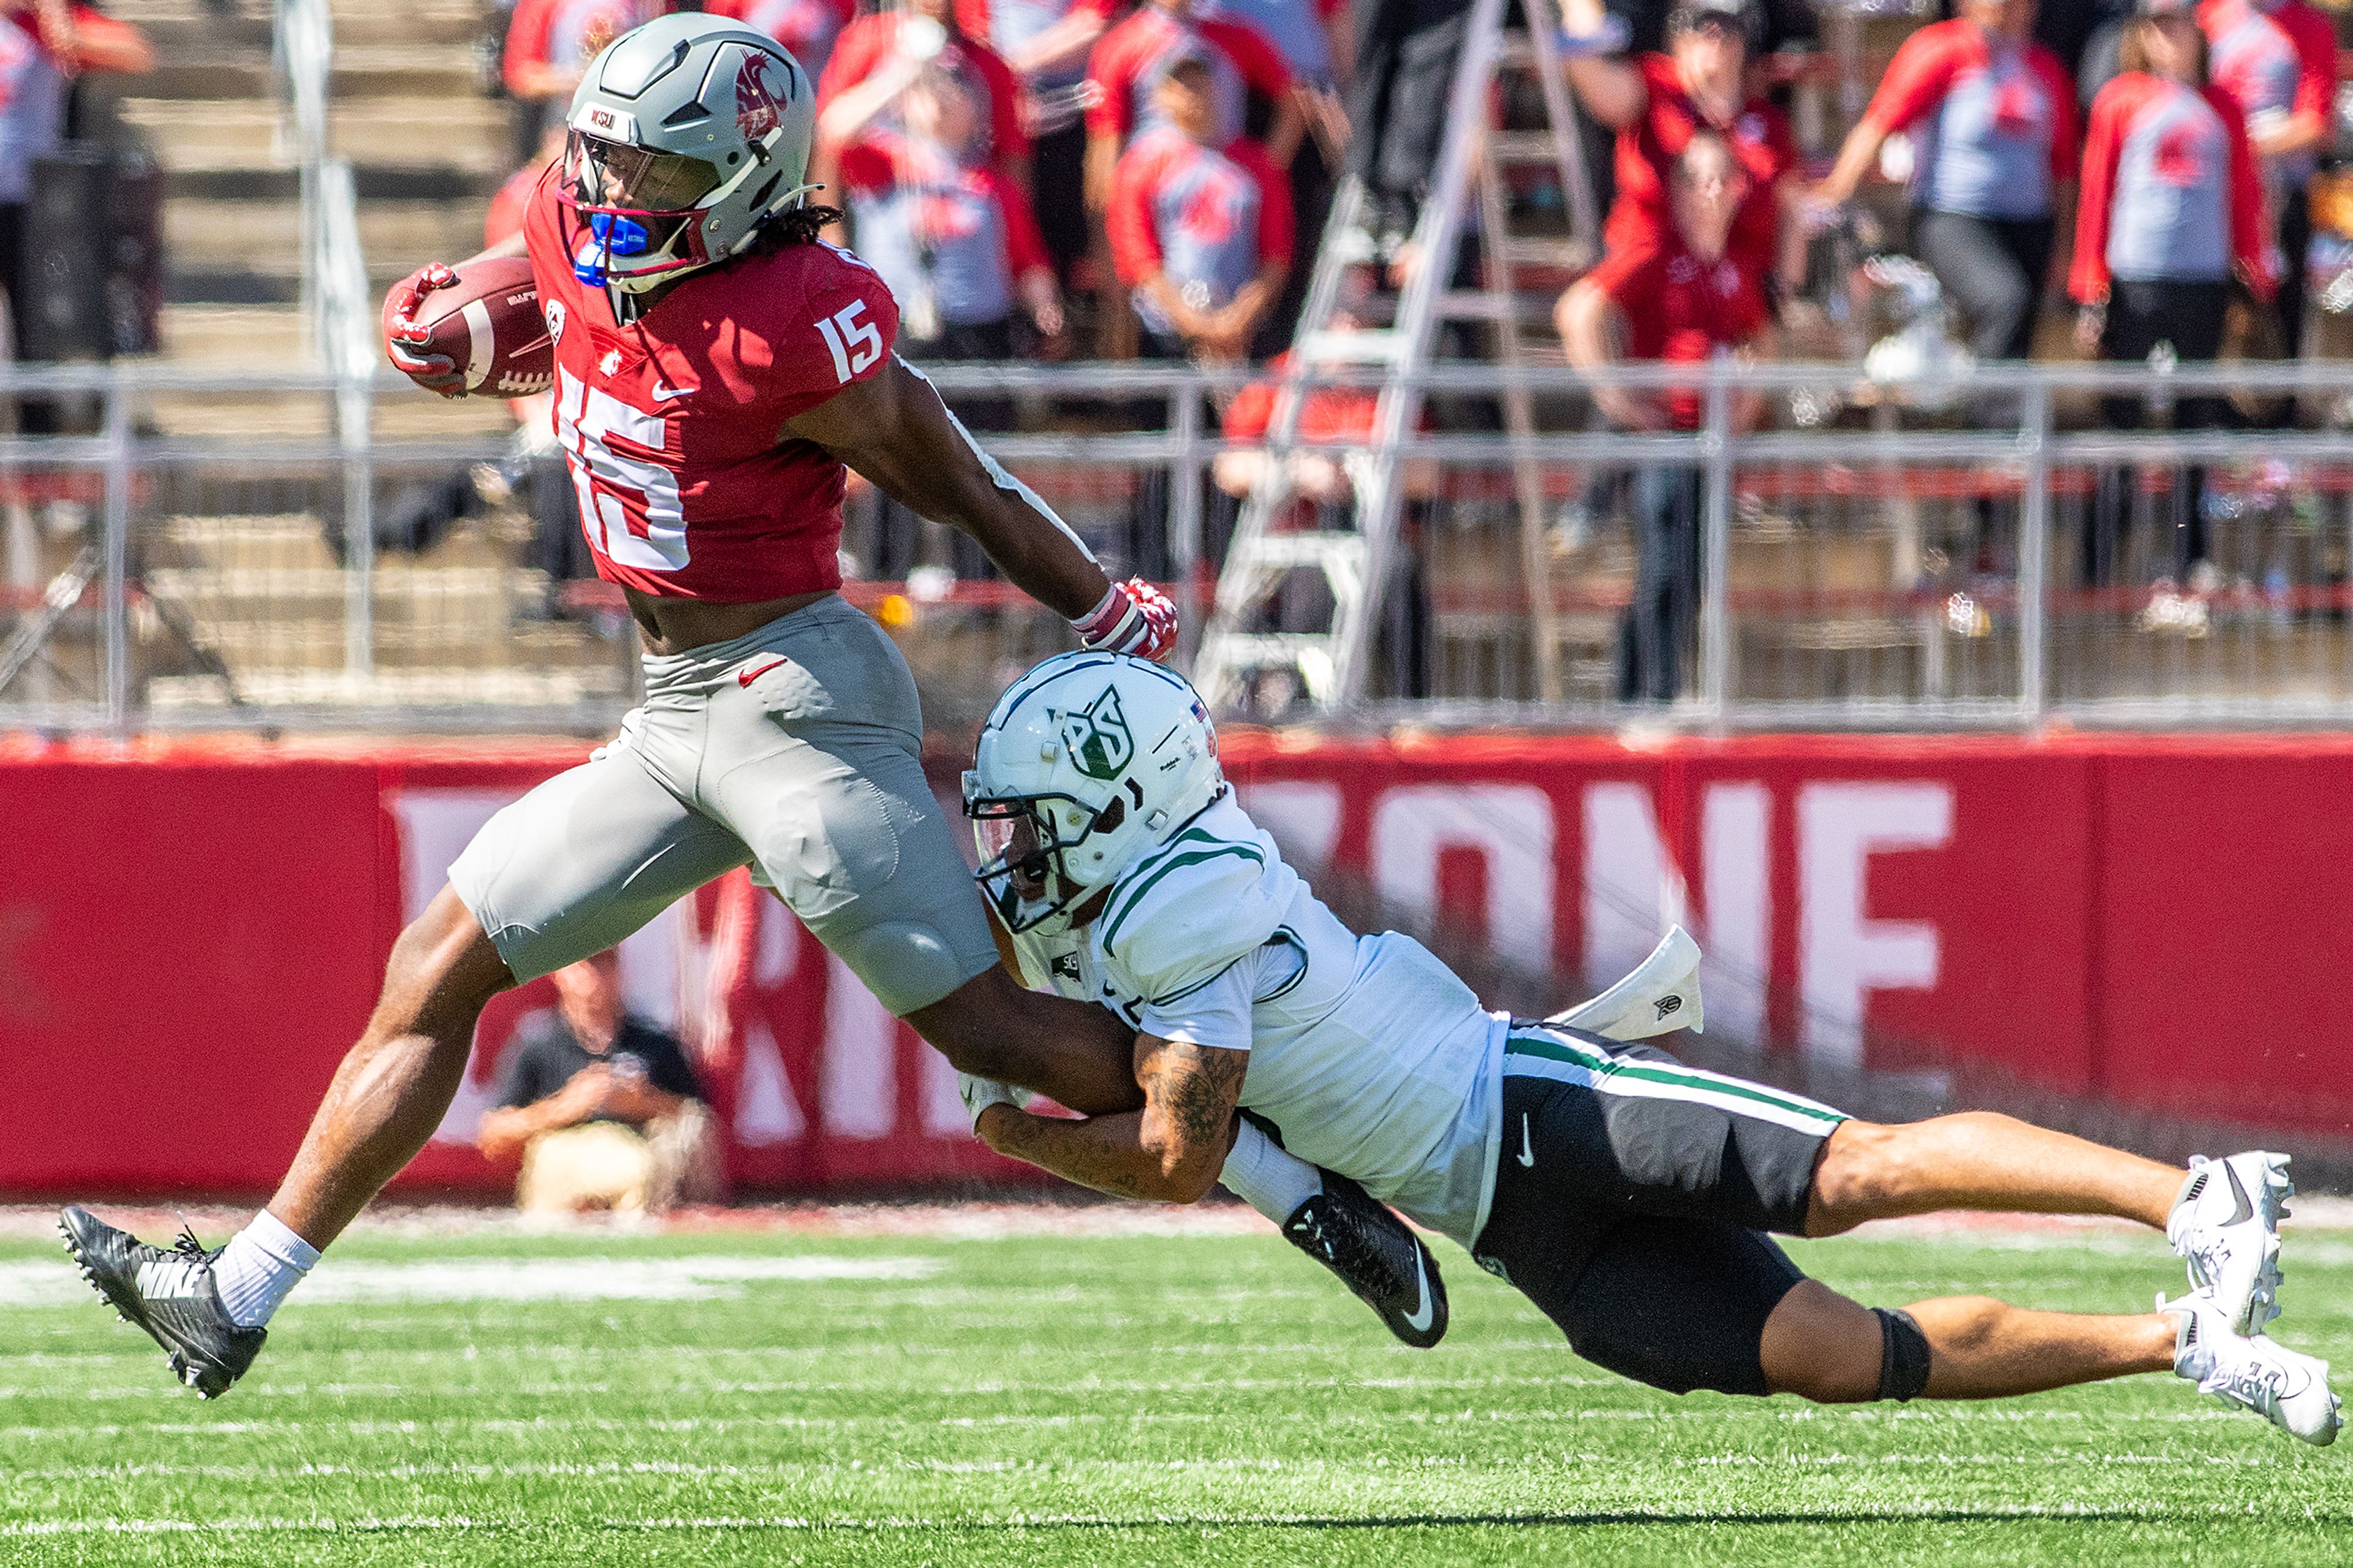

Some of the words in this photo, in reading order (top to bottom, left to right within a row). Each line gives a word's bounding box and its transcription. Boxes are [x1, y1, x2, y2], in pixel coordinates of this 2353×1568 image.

[591, 109, 615, 129] WSU
[814, 298, 883, 384] 15
[135, 1261, 207, 1300] NIKE
